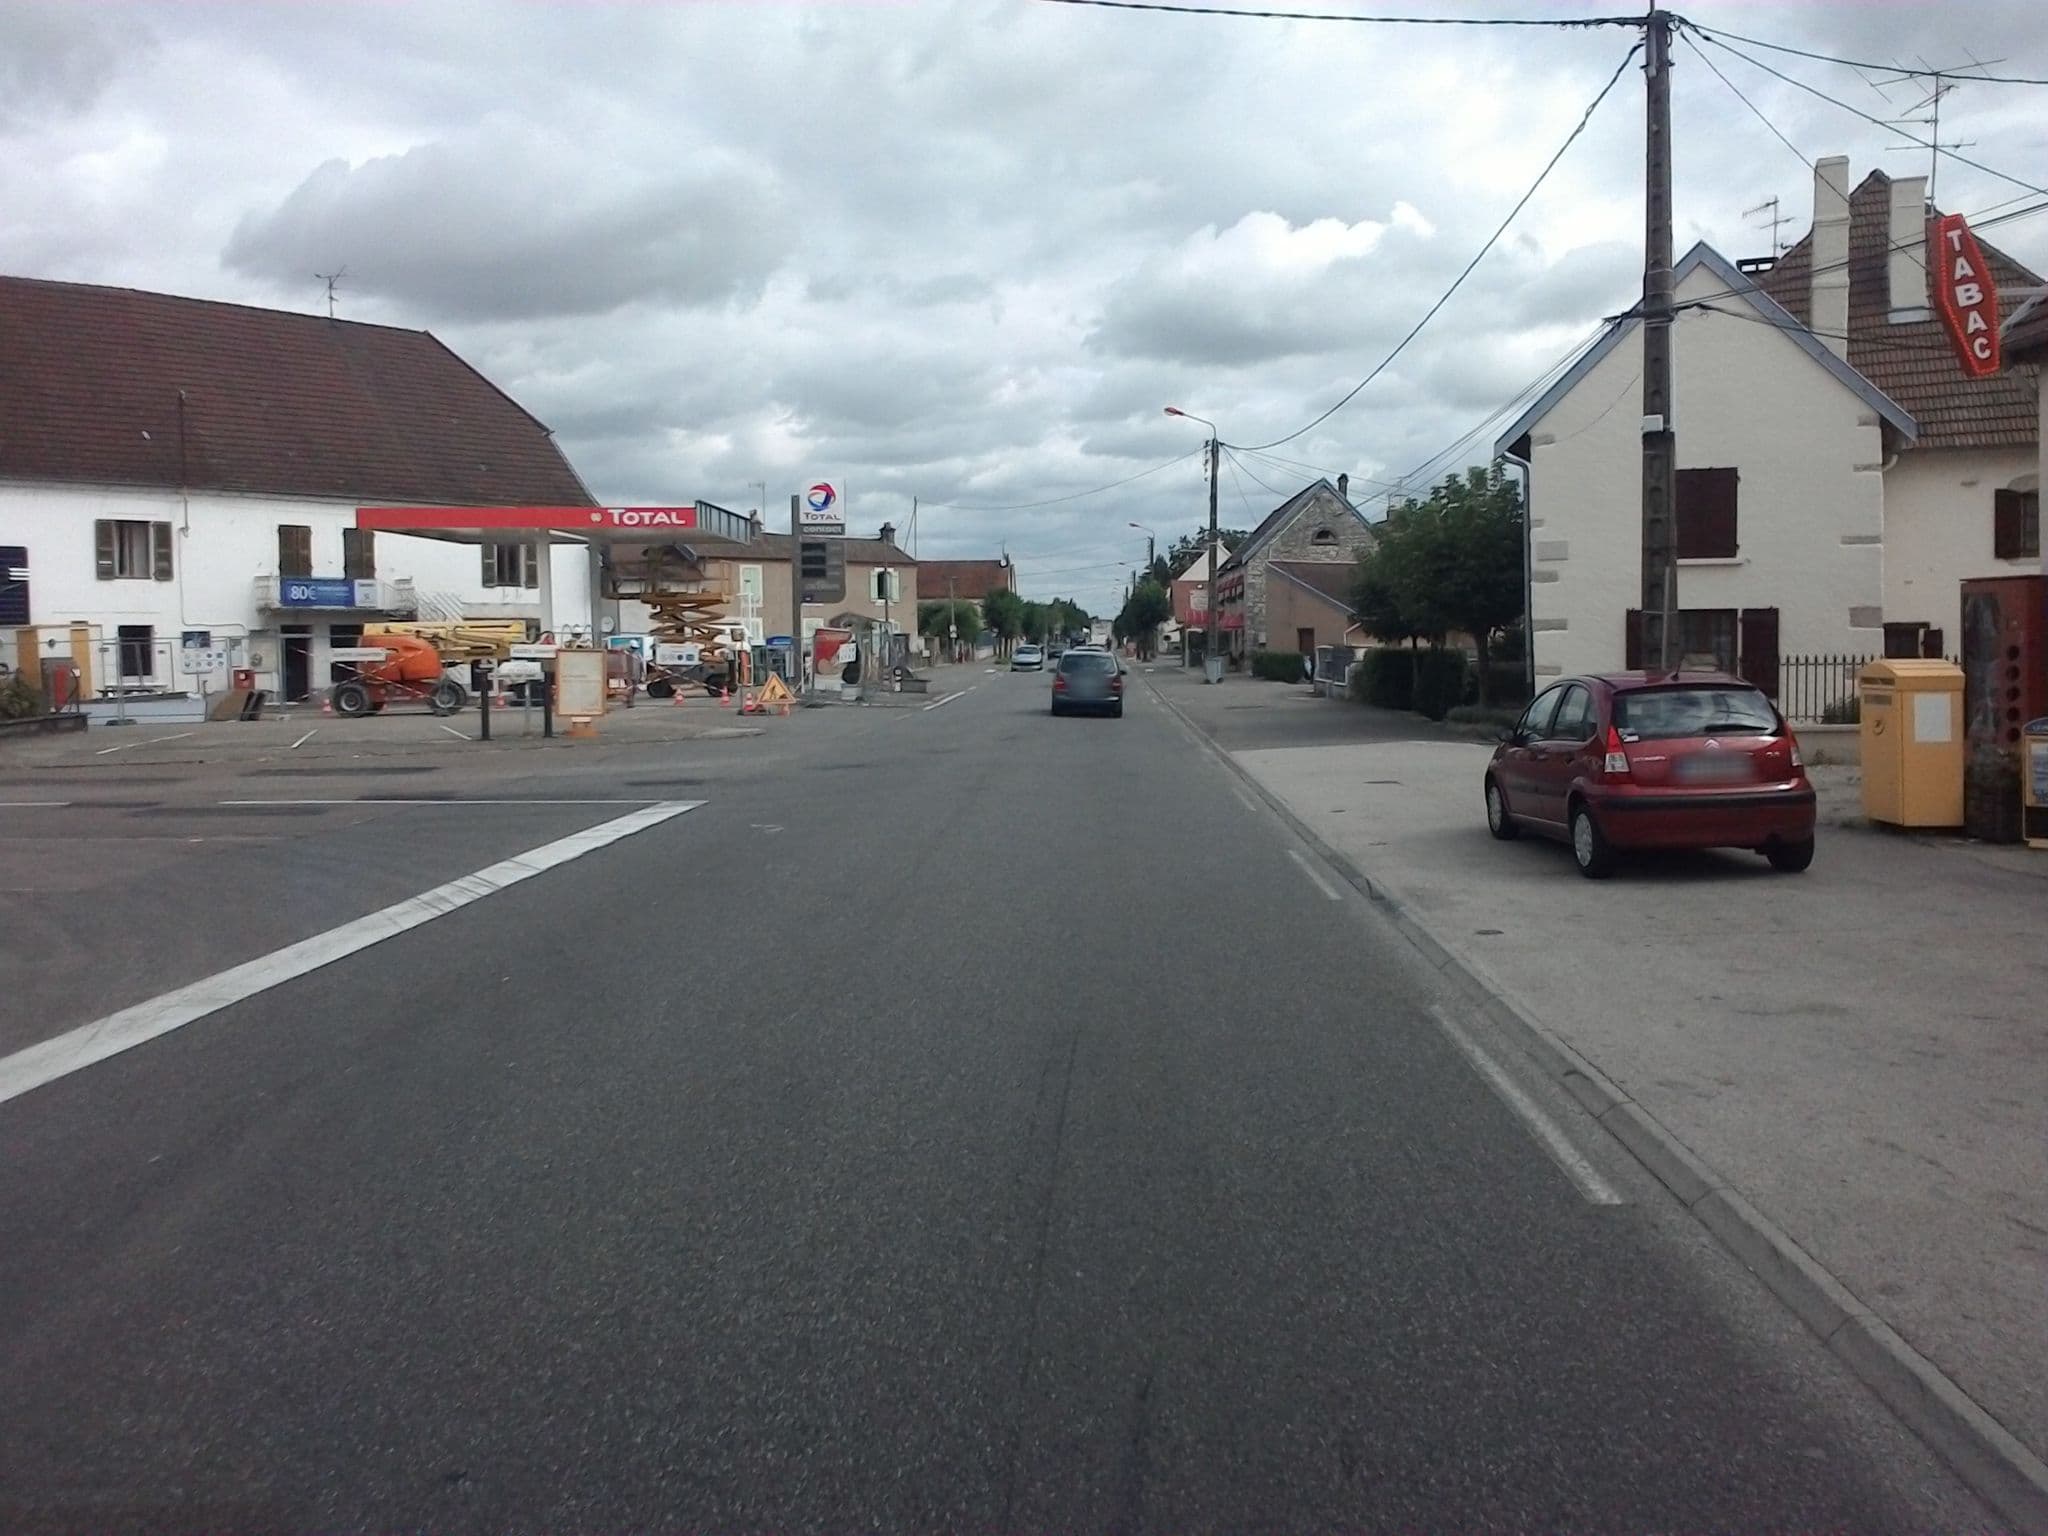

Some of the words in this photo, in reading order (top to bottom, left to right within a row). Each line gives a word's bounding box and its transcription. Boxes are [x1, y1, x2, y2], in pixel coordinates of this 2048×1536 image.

[1946, 229, 1992, 359] TABAC
[607, 508, 686, 526] TOTAL
[803, 511, 842, 521] TOTAL
[290, 585, 318, 600] 80€
